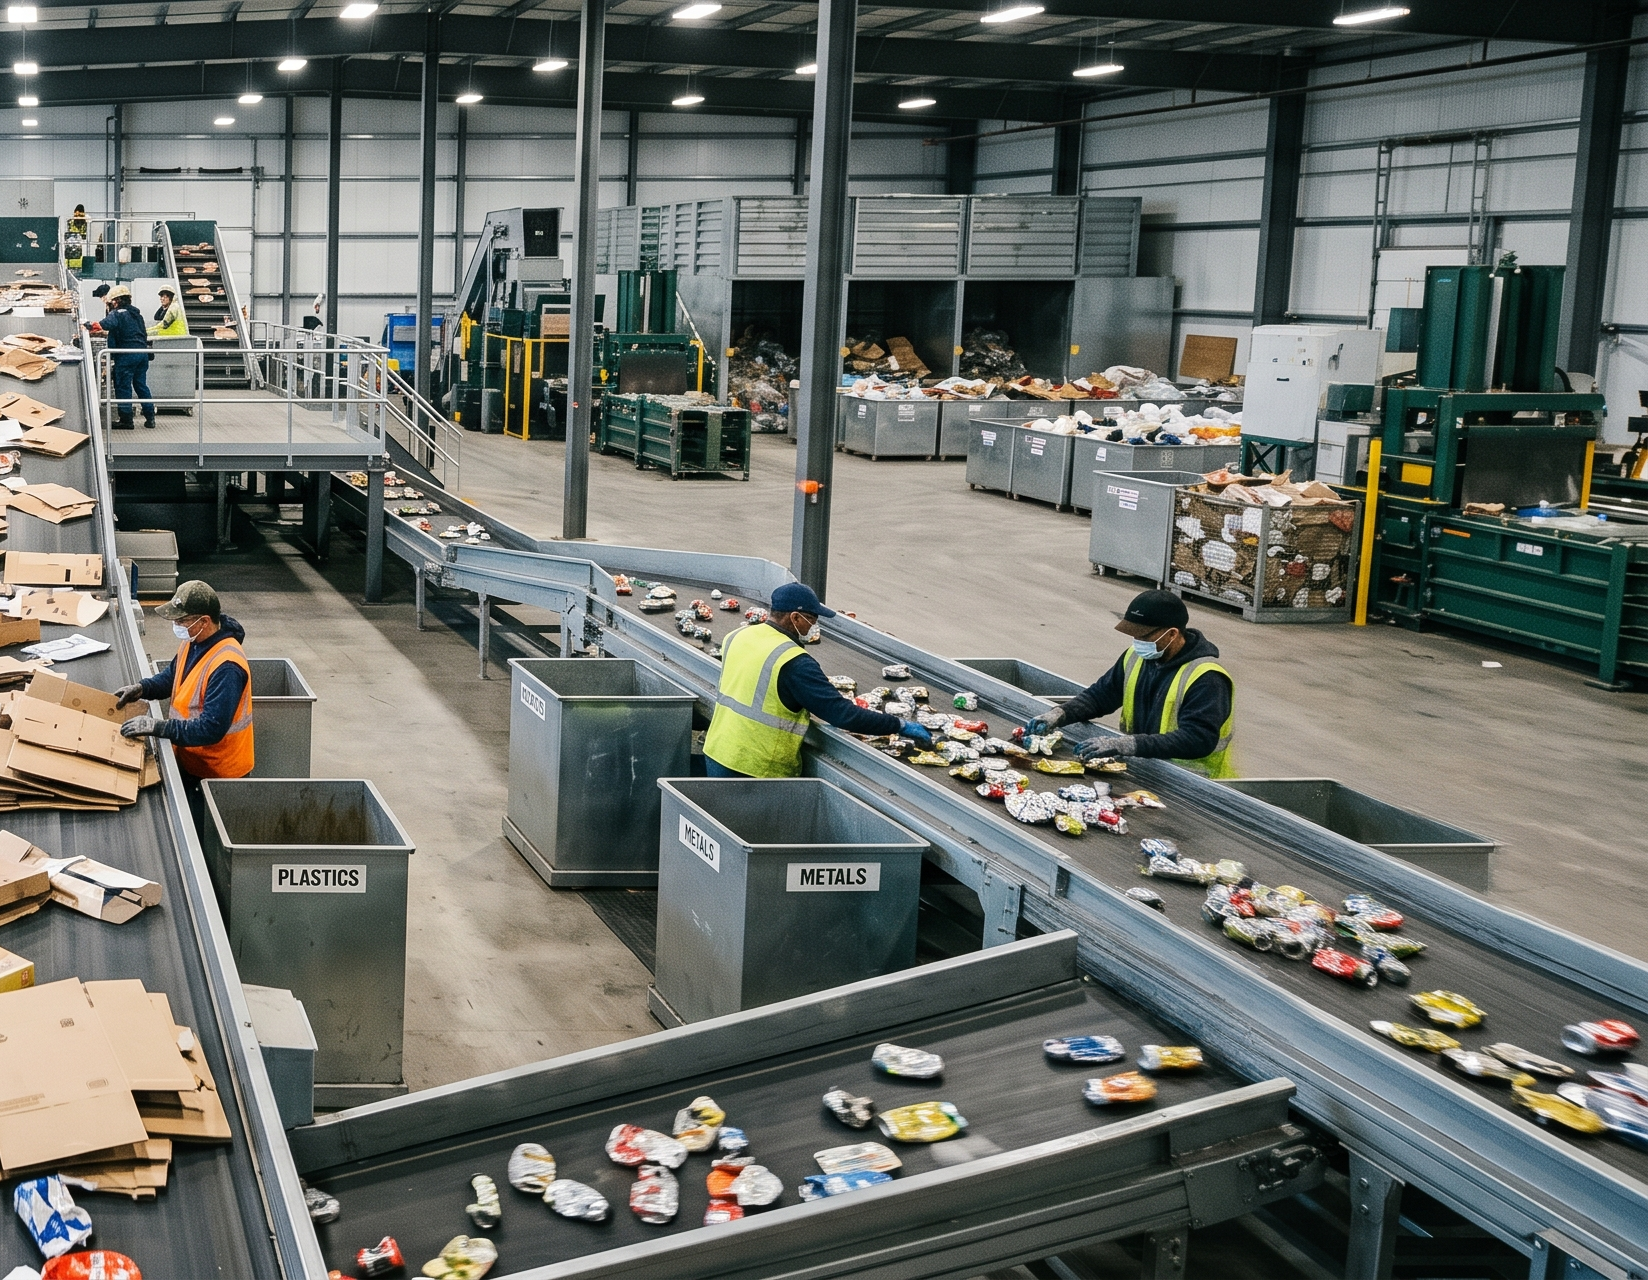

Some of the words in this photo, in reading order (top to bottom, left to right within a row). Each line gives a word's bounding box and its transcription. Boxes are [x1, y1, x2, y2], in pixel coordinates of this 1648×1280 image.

[684, 823, 714, 861] METALS
[278, 869, 359, 886] PLASTICS
[800, 868, 867, 885] METALS
